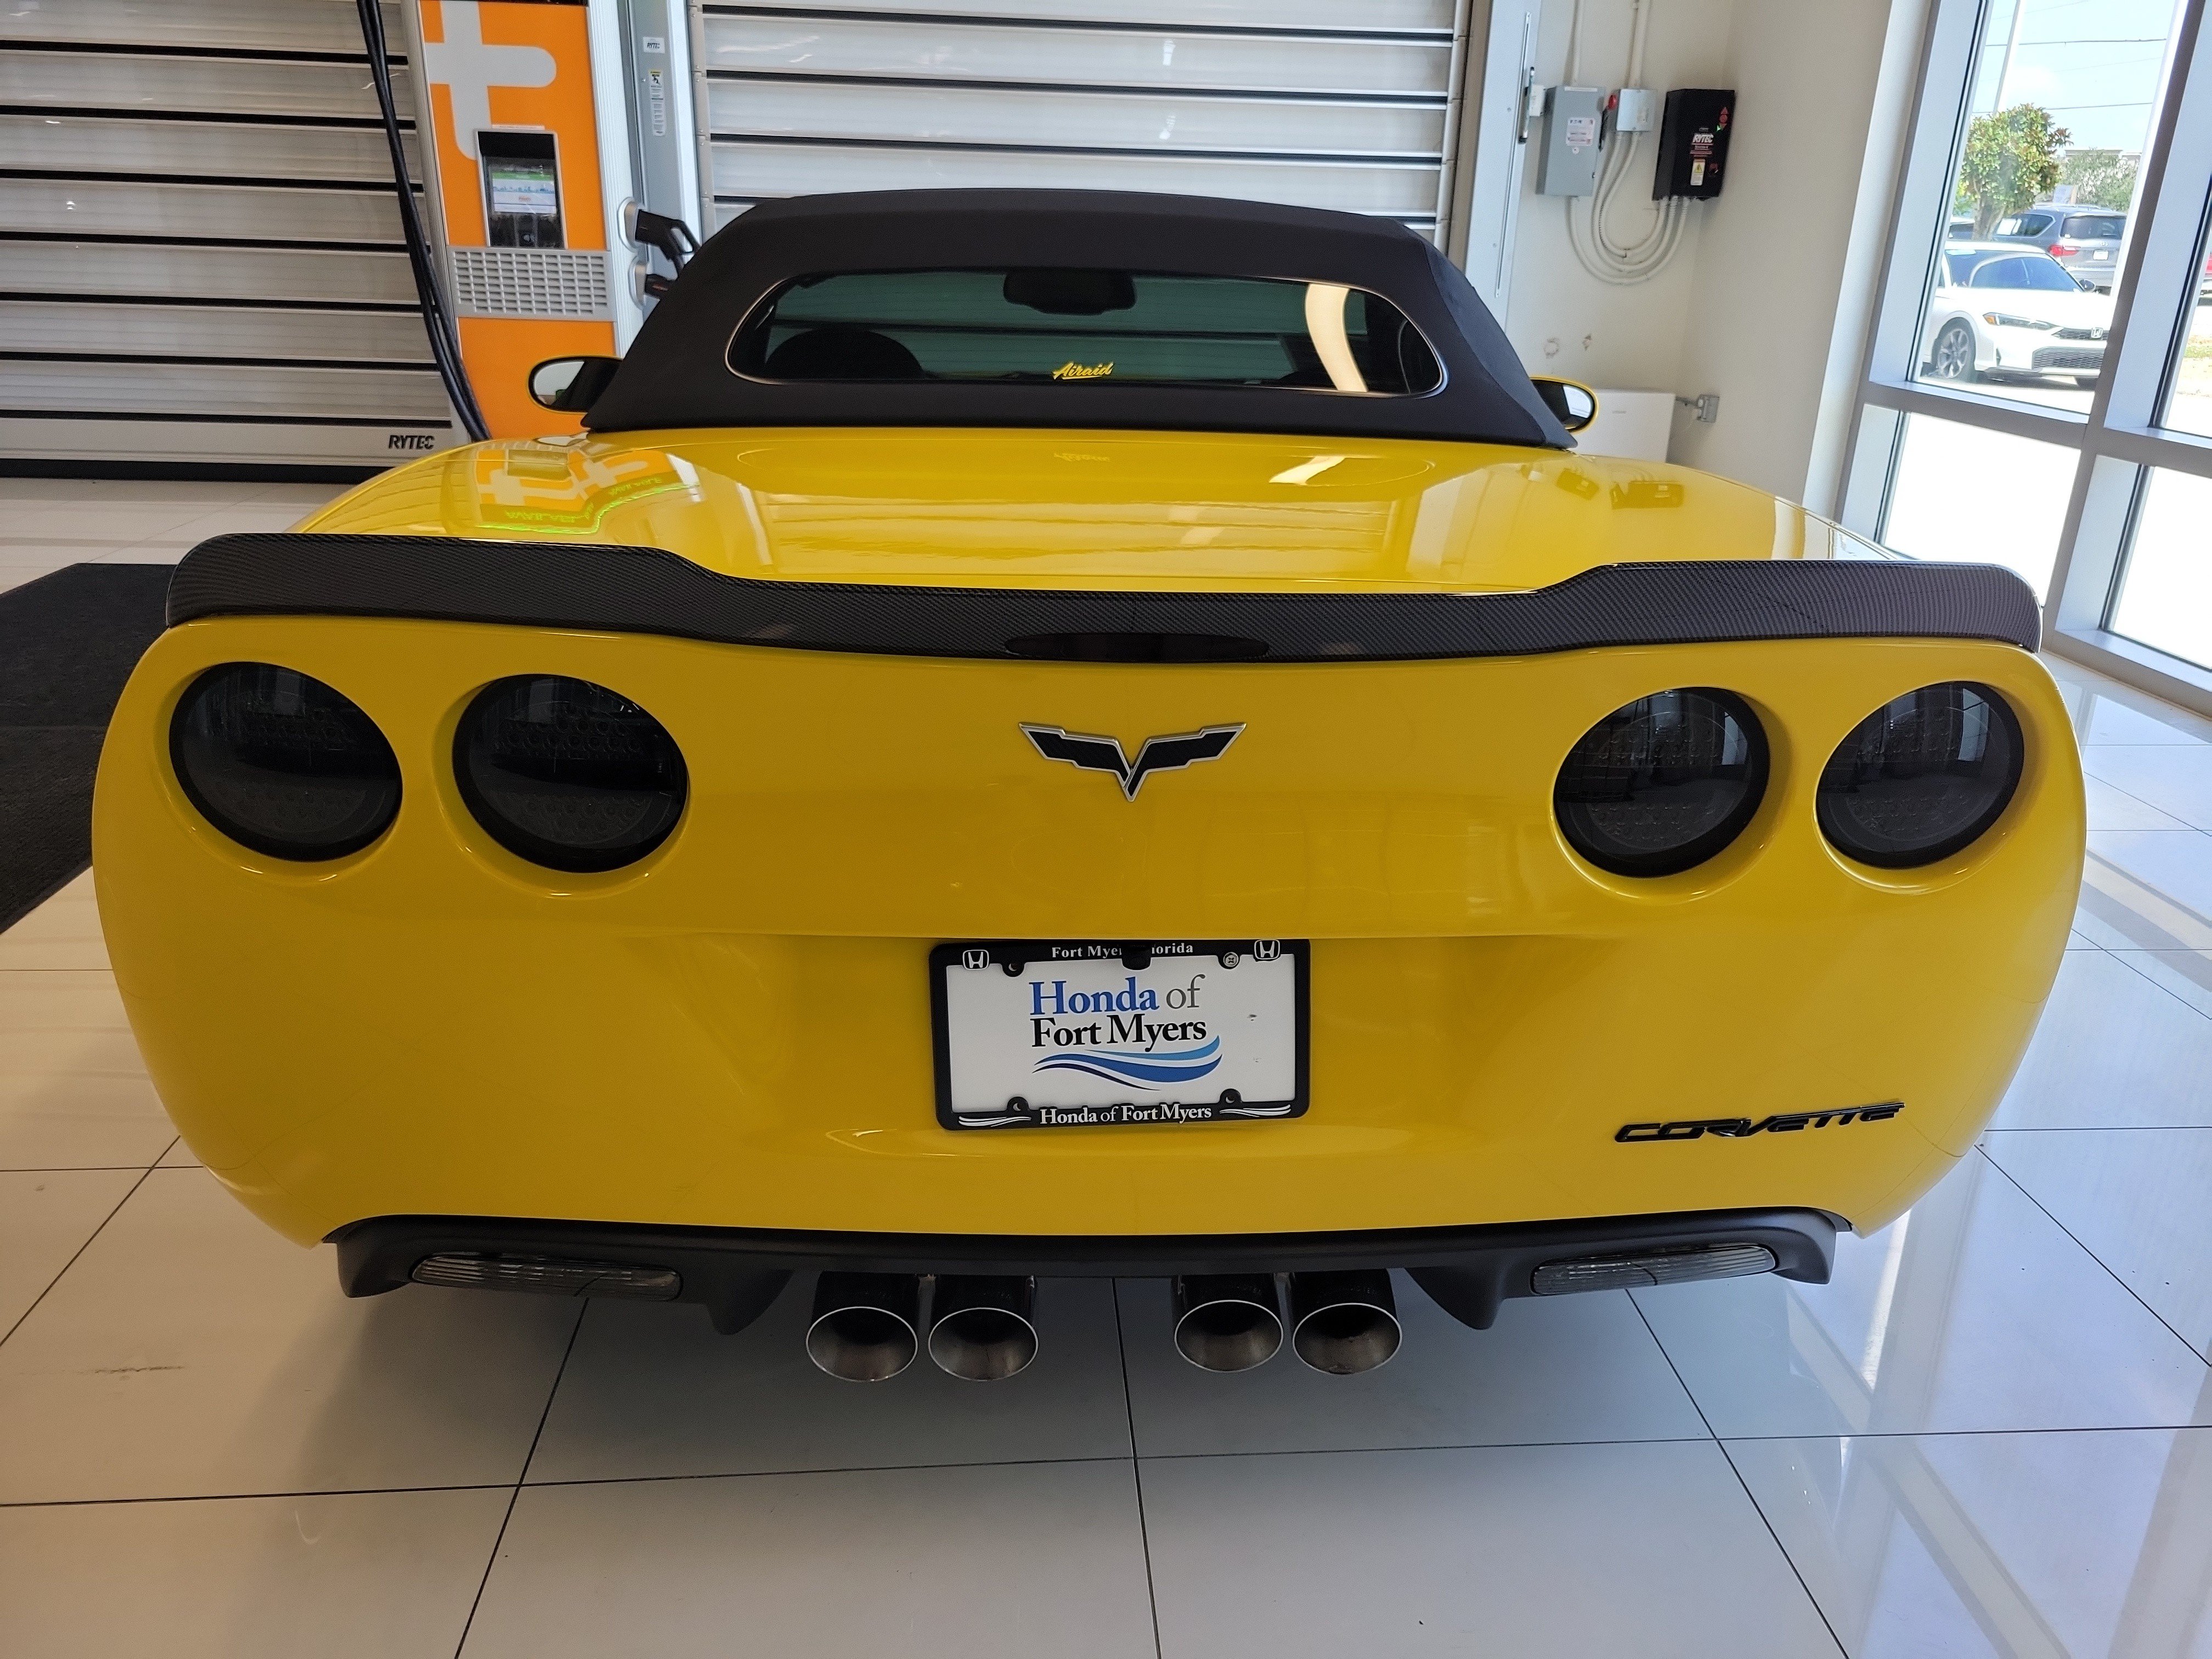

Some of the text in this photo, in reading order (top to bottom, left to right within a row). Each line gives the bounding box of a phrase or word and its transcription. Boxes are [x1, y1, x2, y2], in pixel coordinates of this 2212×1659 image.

[1692, 133, 1714, 143] RYTEC
[1052, 360, 1114, 380] Airaid
[388, 435, 435, 450] RYTEC
[1052, 943, 1193, 959] Fort Mye lorida
[1029, 974, 1206, 1015] Honda of
[1030, 1013, 1207, 1052] Fort Myers
[1039, 1103, 1212, 1125] Honda of Fort Myers
[1615, 1102, 1906, 1143] CORVETTE
